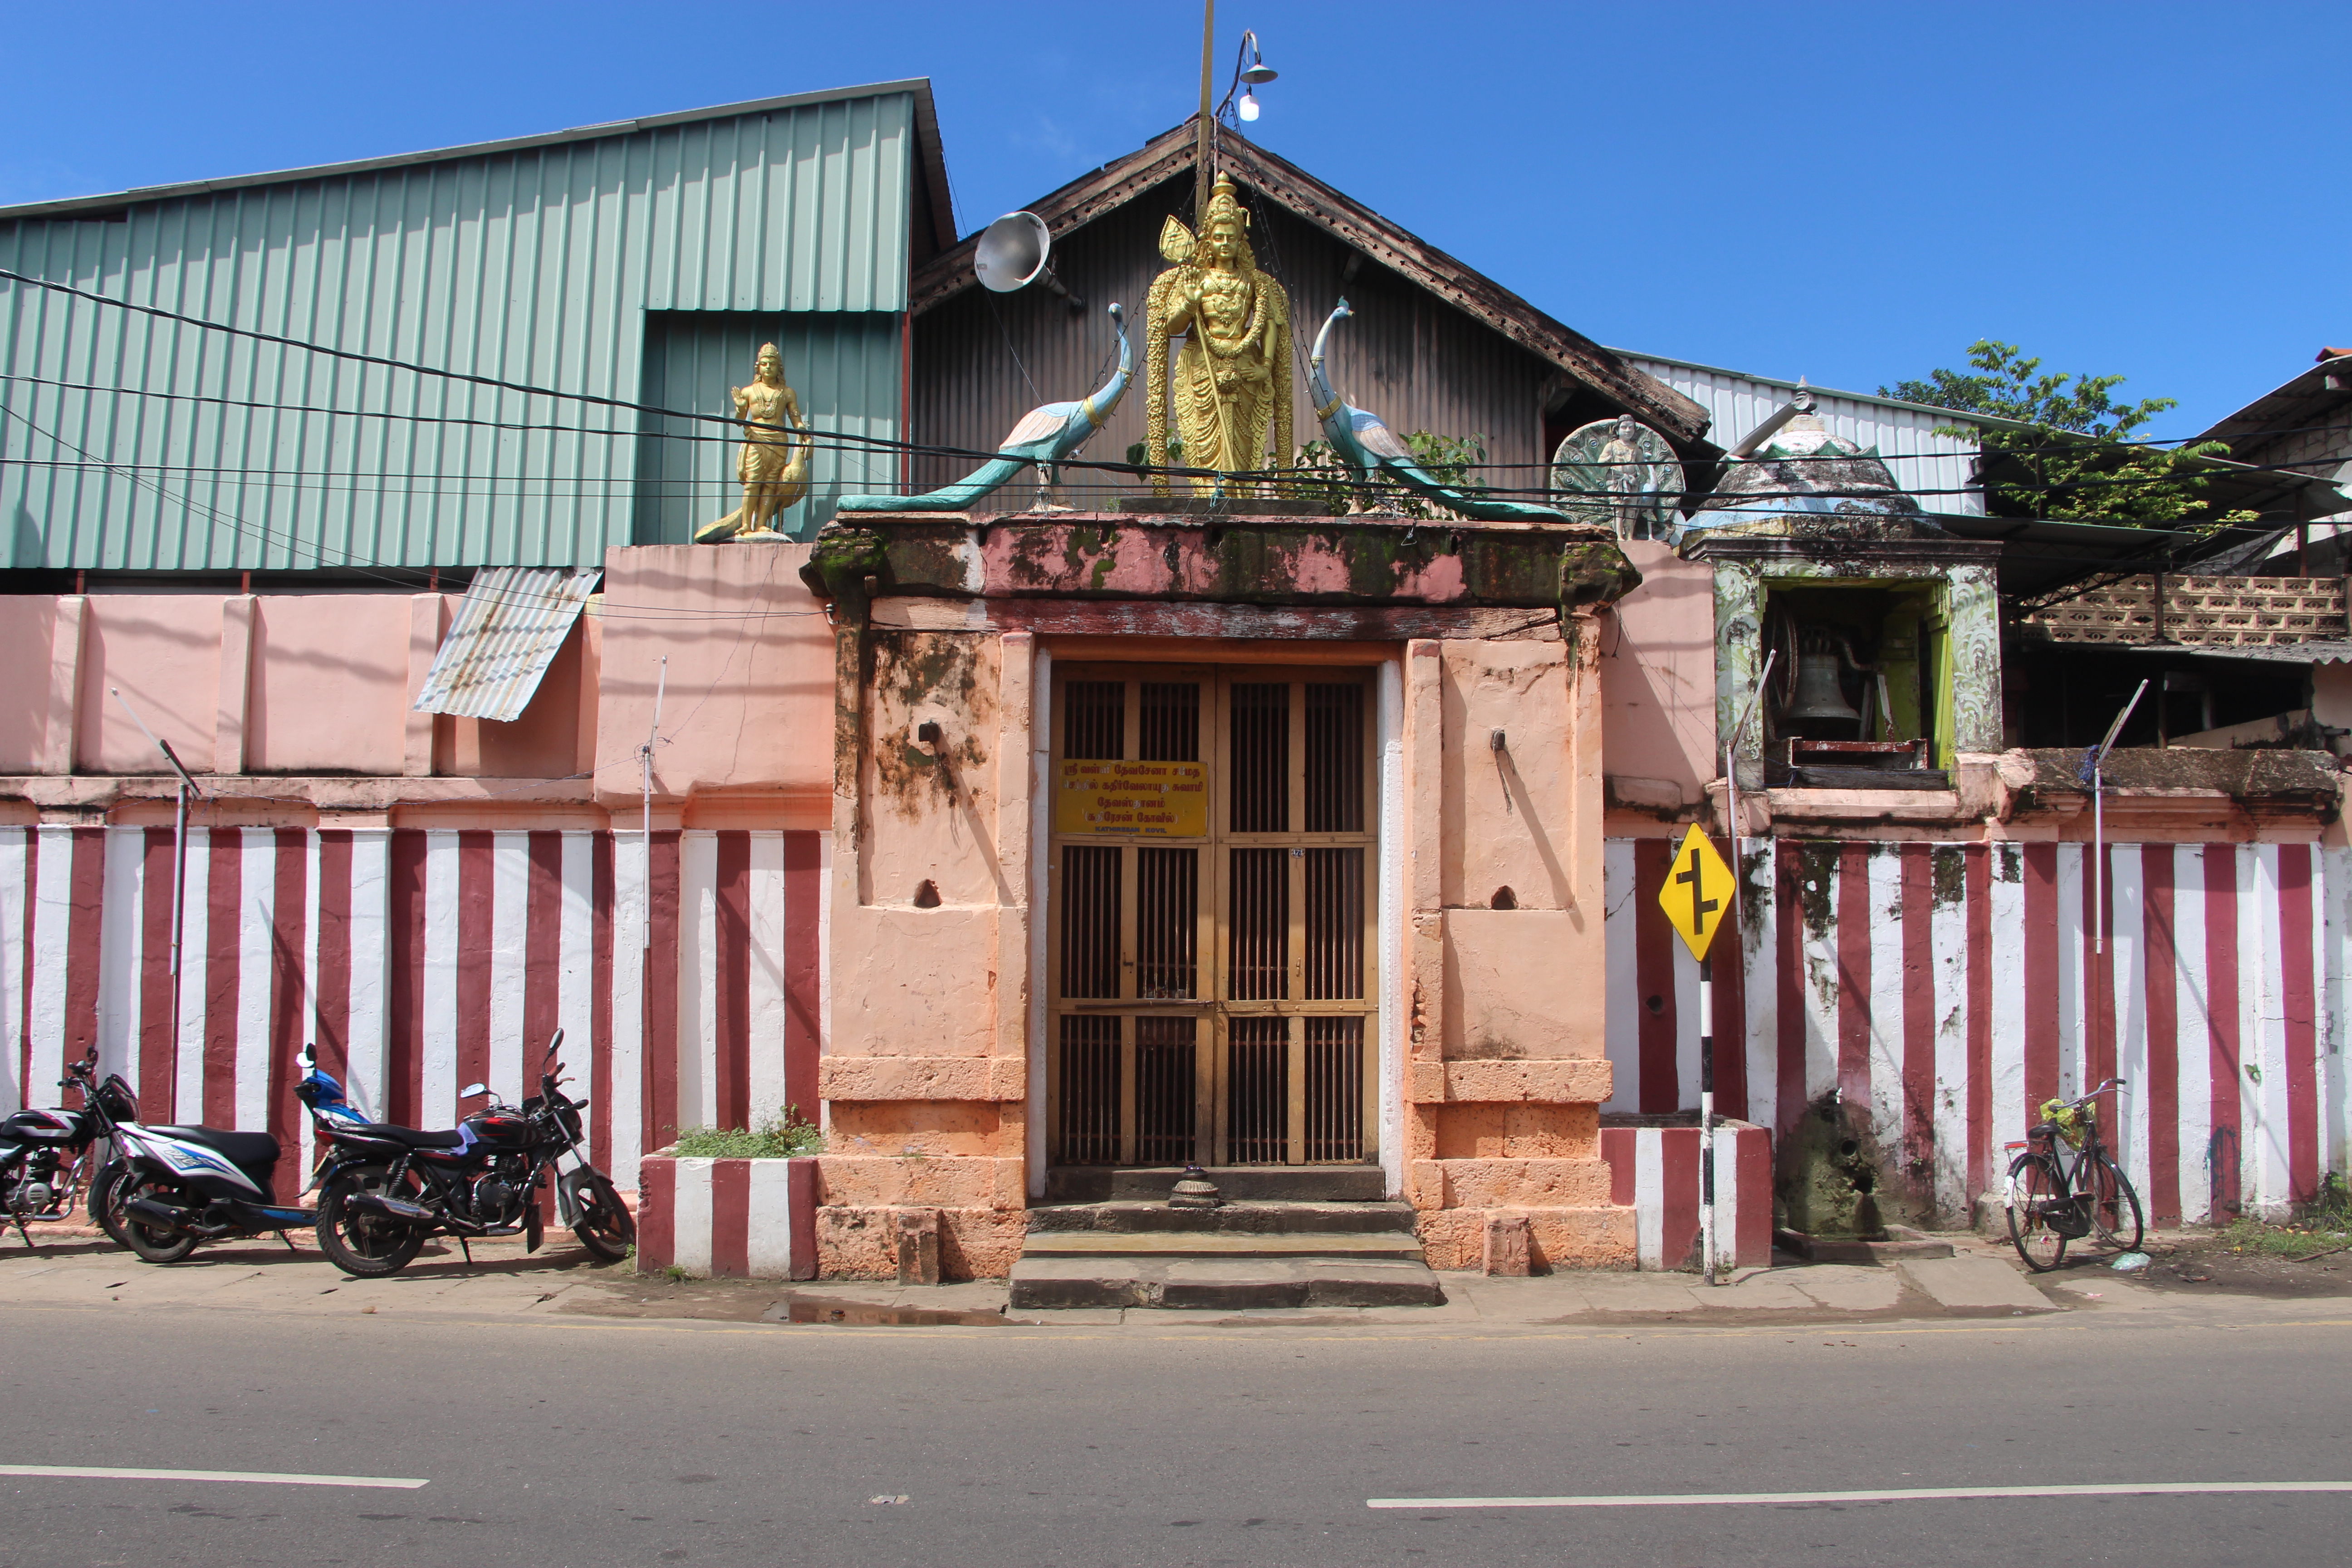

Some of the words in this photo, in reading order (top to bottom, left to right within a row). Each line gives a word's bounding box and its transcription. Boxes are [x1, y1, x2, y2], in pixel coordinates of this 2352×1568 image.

[1080, 763, 1110, 774] வள்ளி
[1114, 764, 1167, 777] தேவசேனா
[1172, 766, 1200, 779] சமேத
[1063, 779, 1098, 792] செந்தில்
[1102, 779, 1169, 793] கதிர்வேலாயுத
[1172, 781, 1203, 792] சுவாமி
[1097, 796, 1165, 810] தேவஸ்தானம்
